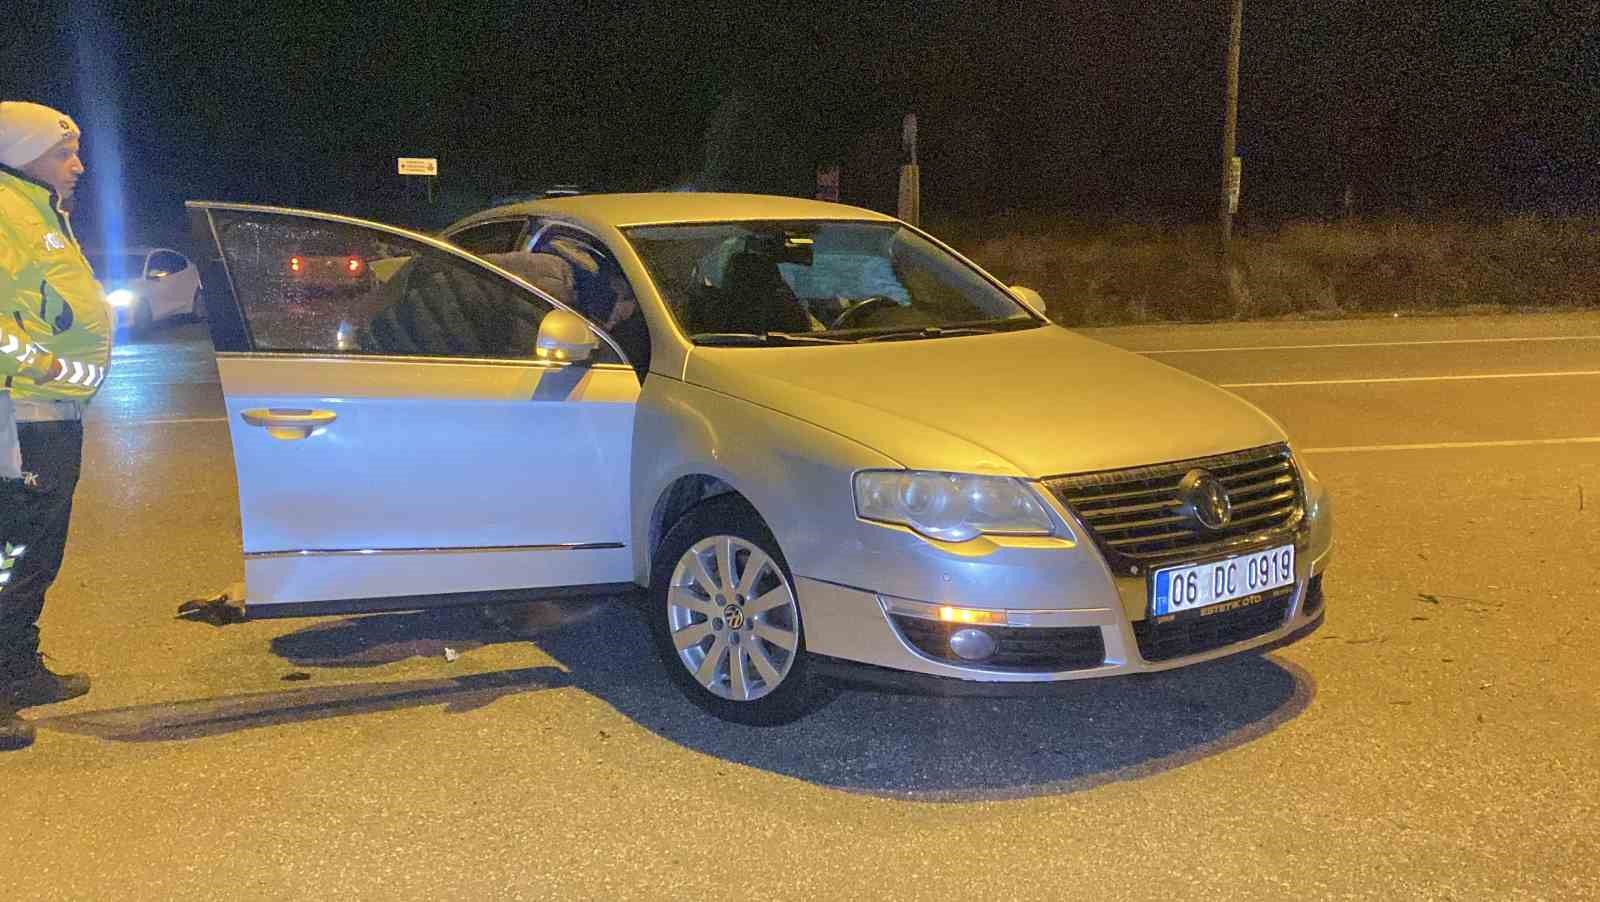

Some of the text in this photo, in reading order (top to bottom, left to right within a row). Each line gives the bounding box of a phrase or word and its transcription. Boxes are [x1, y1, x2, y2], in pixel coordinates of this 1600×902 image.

[1172, 550, 1290, 607] 06 DC 0919
